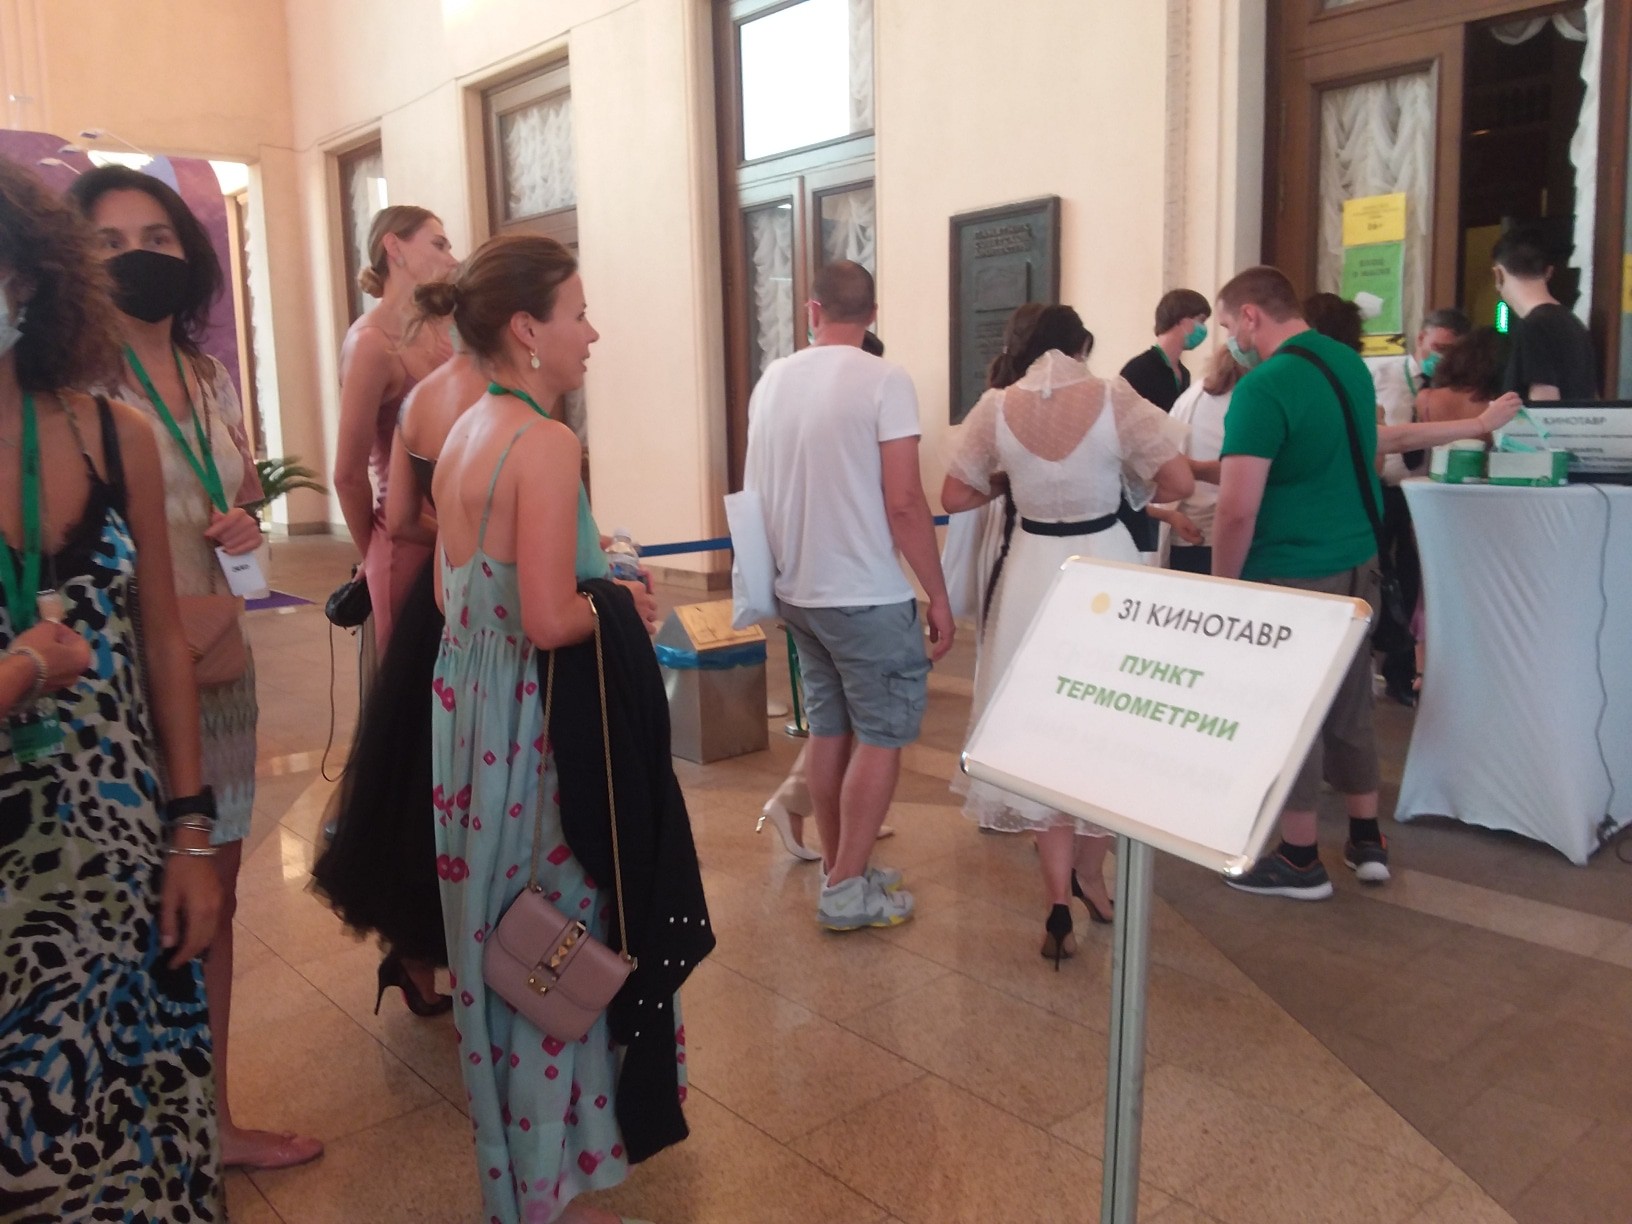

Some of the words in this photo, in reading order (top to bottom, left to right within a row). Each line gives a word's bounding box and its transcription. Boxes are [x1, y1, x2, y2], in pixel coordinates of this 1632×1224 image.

[1118, 599, 1141, 622] 31
[1147, 603, 1292, 649] КИНОТАВР
[1119, 654, 1205, 689] ПУНКТ
[1054, 675, 1239, 741] ТЕРМОМЕТРИИ
